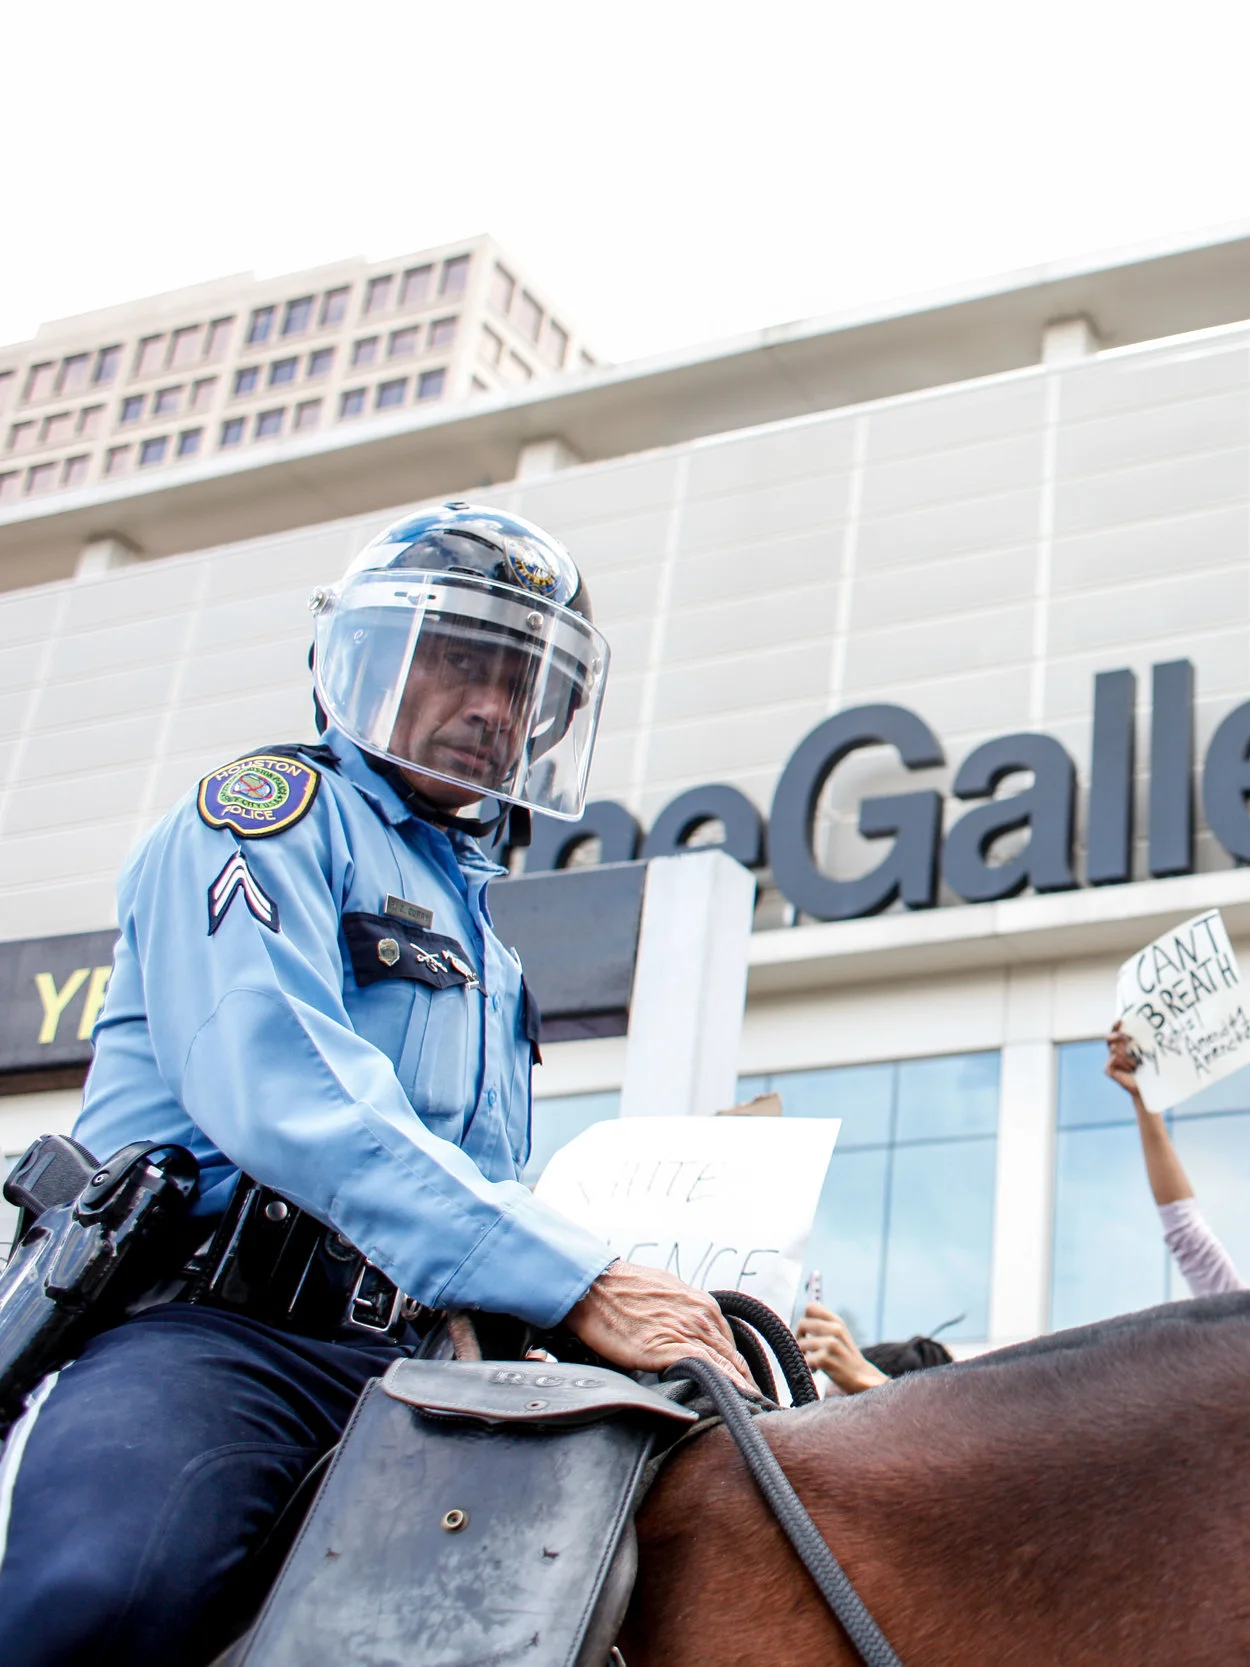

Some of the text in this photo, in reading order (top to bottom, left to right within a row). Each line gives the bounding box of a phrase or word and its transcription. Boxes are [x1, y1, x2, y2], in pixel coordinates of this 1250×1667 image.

[215, 760, 302, 781] HOUSTON
[220, 805, 276, 820] POLICE
[1135, 953, 1240, 1031] BREATH
